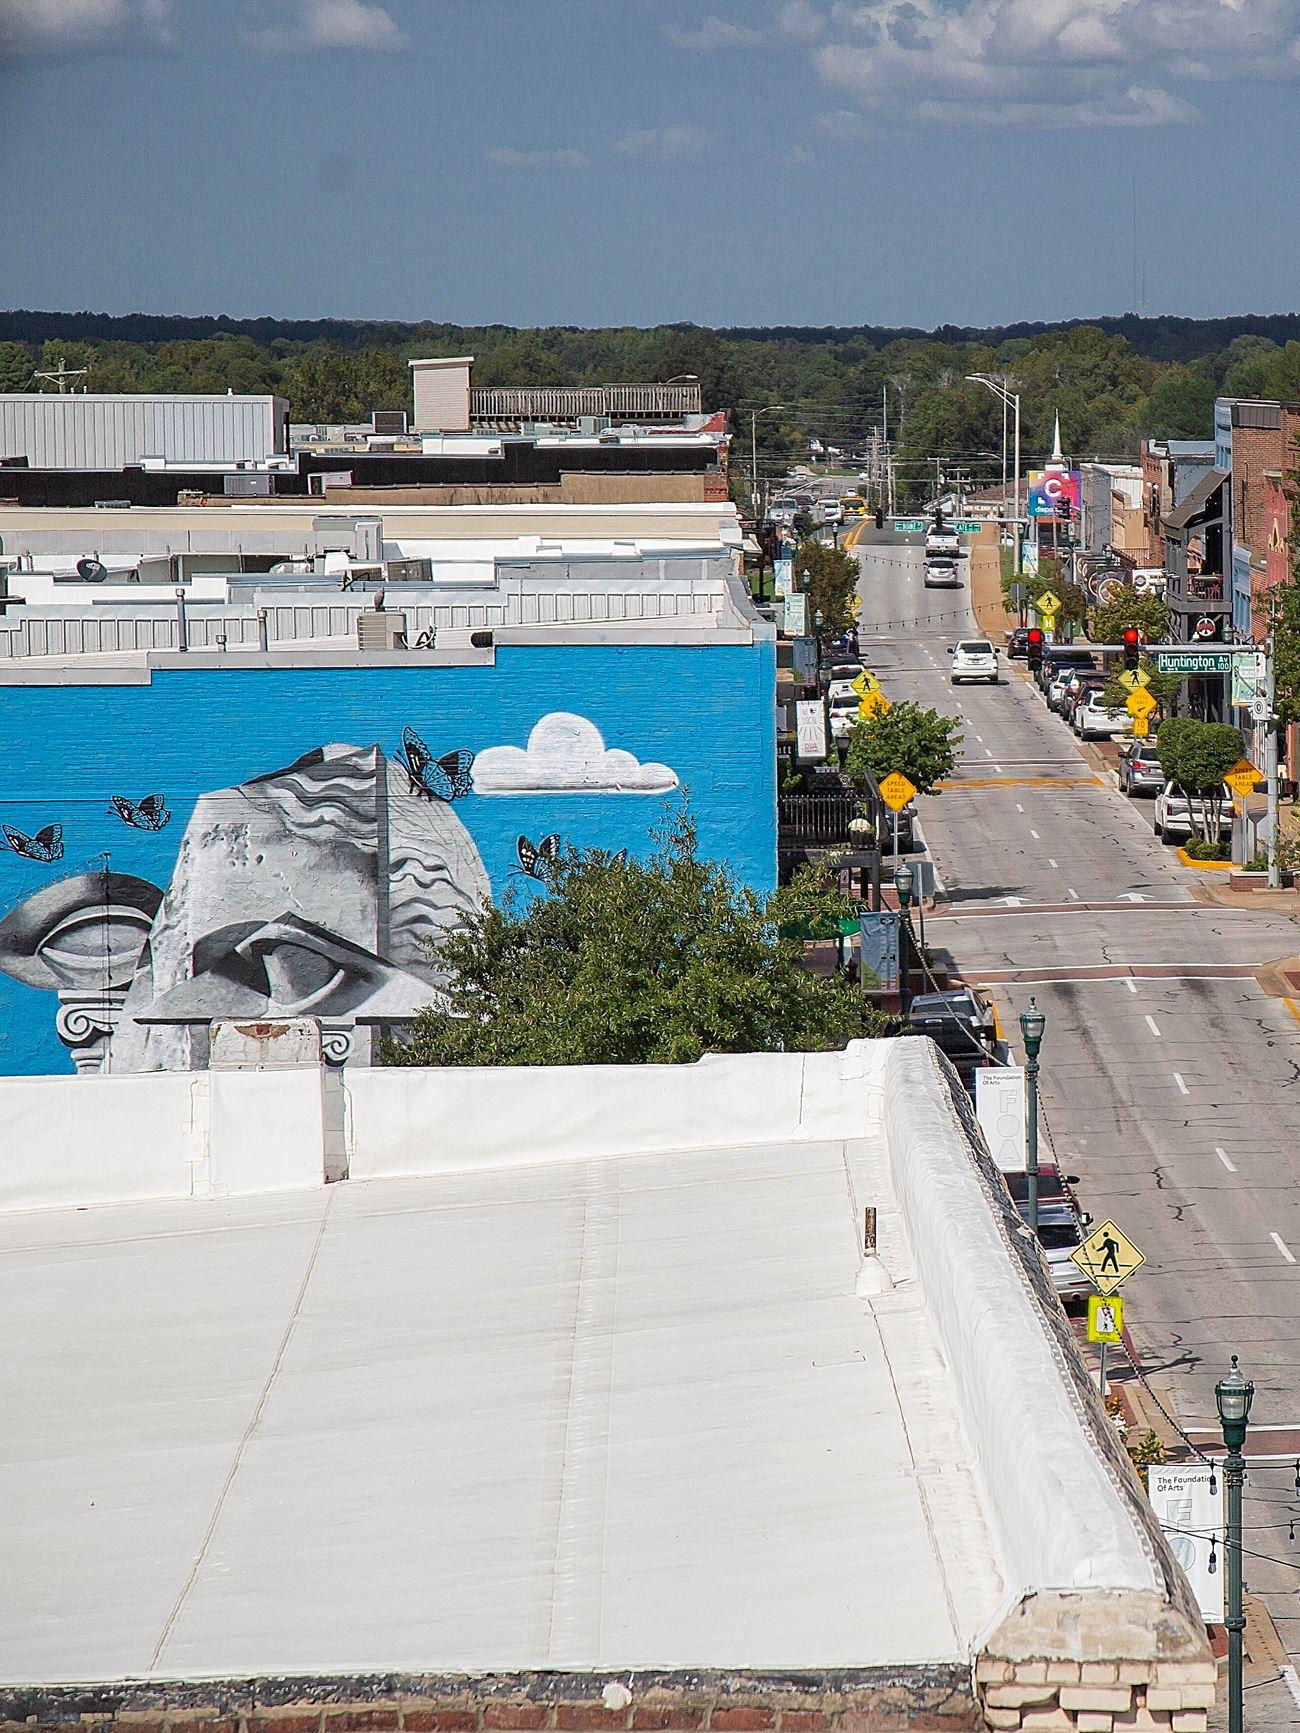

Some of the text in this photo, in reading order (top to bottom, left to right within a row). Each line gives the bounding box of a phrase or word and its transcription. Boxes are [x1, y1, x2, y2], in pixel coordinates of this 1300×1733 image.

[1161, 656, 1215, 669] Huntington
[1173, 1475, 1211, 1484] Foundatio
[1157, 1483, 1184, 1492] Of Arts
